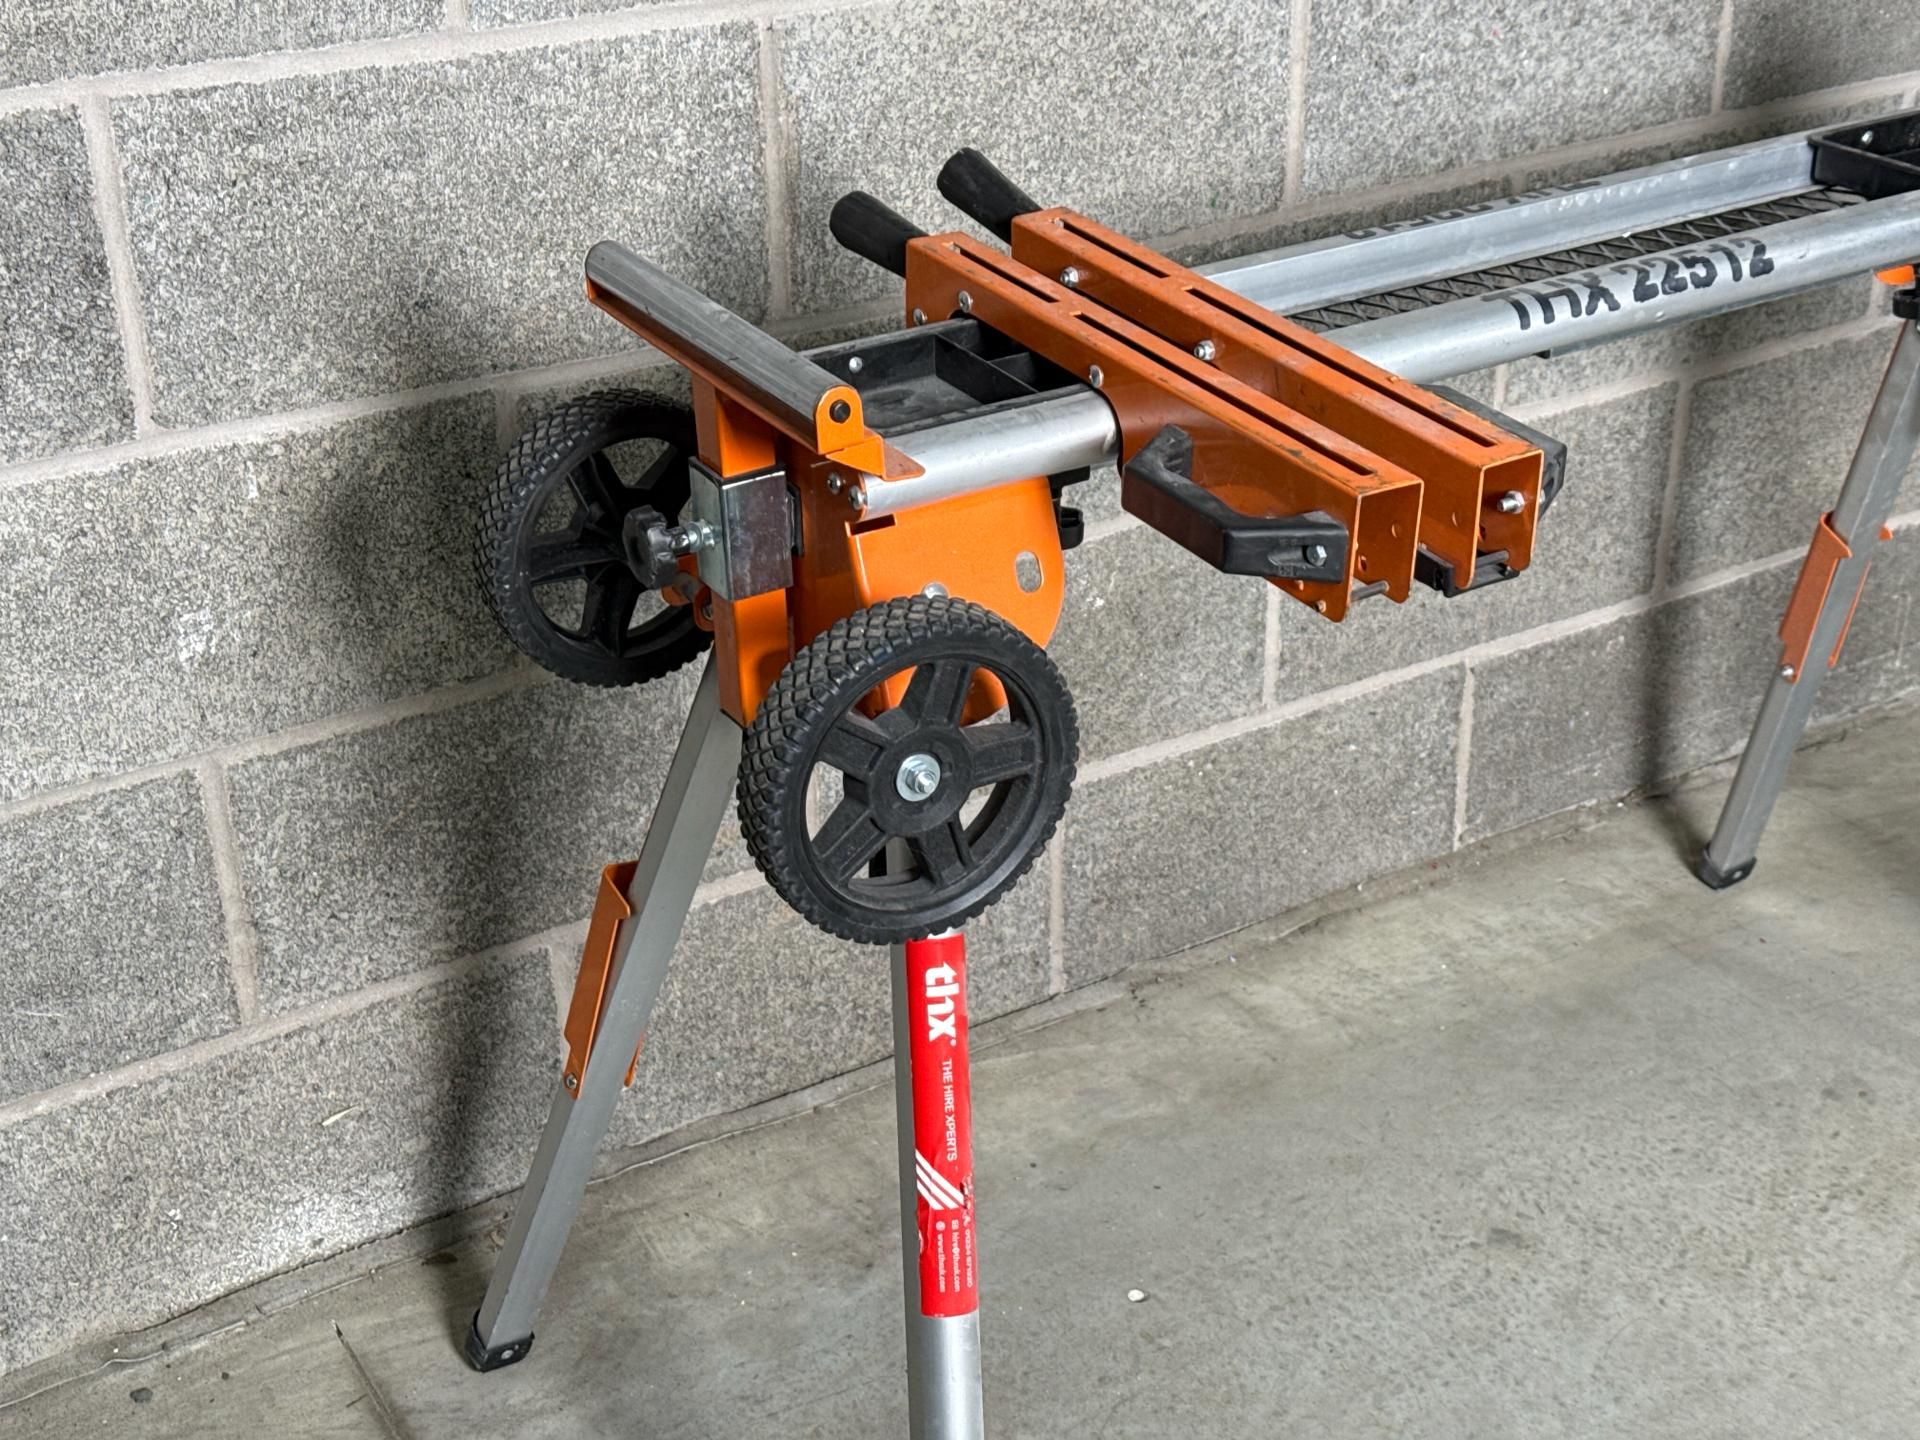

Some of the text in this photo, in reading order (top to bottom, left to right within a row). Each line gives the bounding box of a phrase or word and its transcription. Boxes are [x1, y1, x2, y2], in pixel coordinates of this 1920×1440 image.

[1480, 272, 1621, 331] THX
[925, 961, 960, 1043] thx
[942, 1058, 958, 1162] THE HIRE XPERTS
